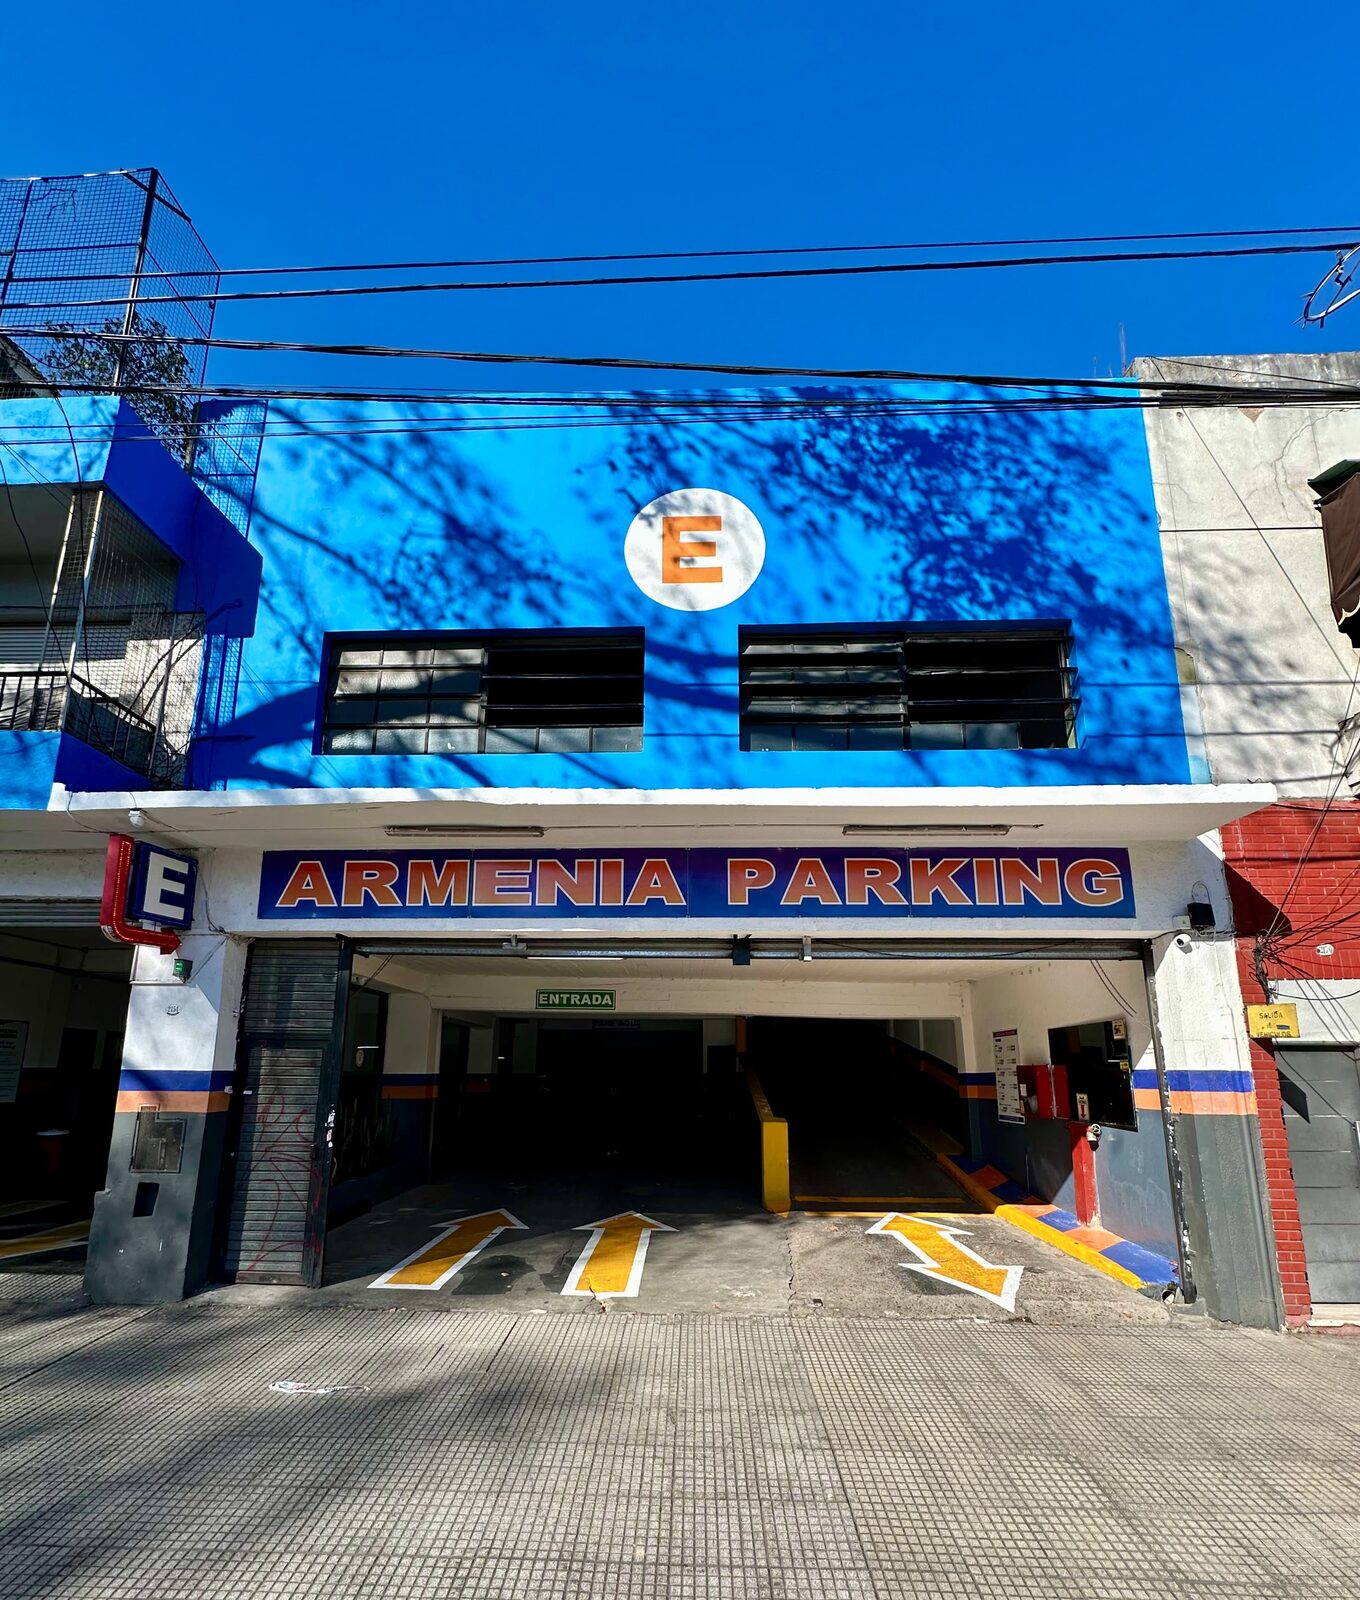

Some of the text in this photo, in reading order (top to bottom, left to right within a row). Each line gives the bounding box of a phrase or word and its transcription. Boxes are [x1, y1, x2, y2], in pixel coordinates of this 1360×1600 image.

[661, 515, 723, 584] E
[143, 851, 189, 920] E
[275, 855, 1125, 908] ARMENIA PARKING
[539, 993, 613, 1005] ENTRADA
[1259, 1011, 1284, 1019] SALIDA
